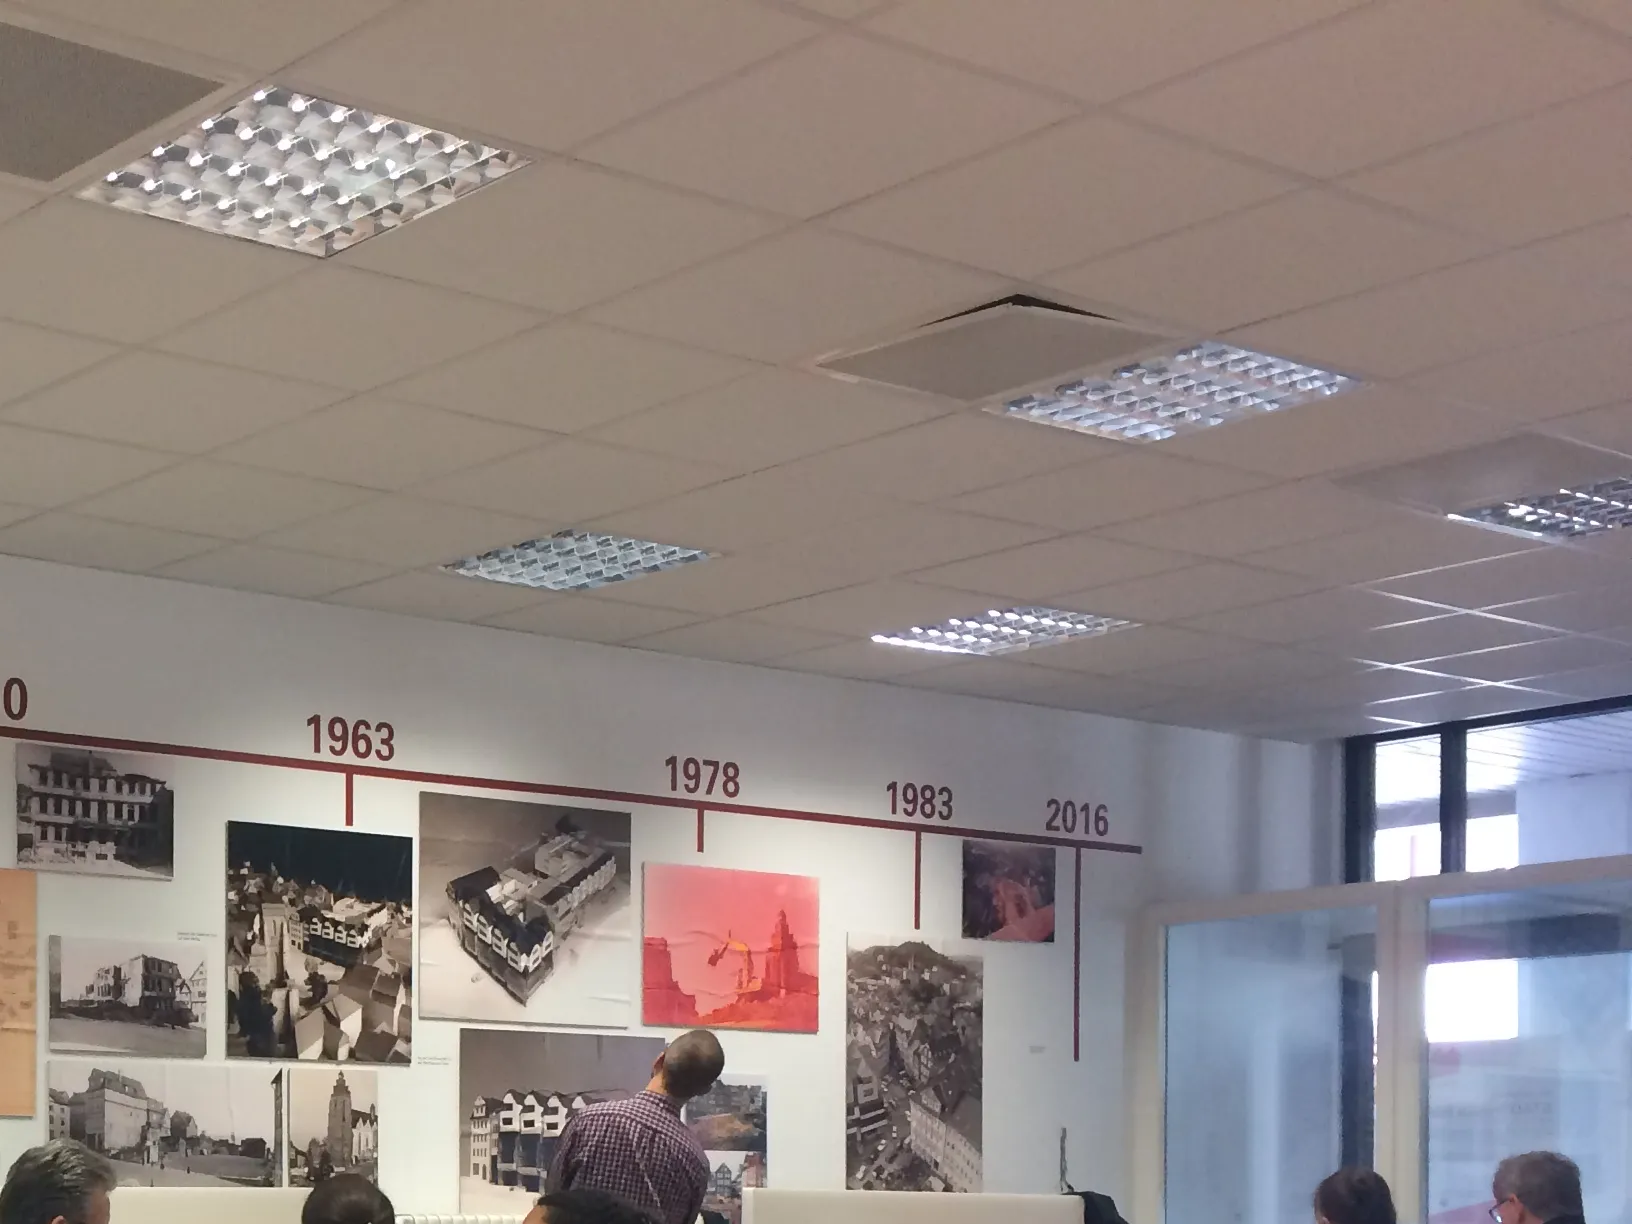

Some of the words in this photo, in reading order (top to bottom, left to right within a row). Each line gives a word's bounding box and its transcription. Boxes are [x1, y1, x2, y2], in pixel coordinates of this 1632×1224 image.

[306, 713, 395, 762] 1963
[664, 755, 740, 798] 1978
[885, 780, 954, 821] 1983
[1045, 798, 1109, 837] 2016
